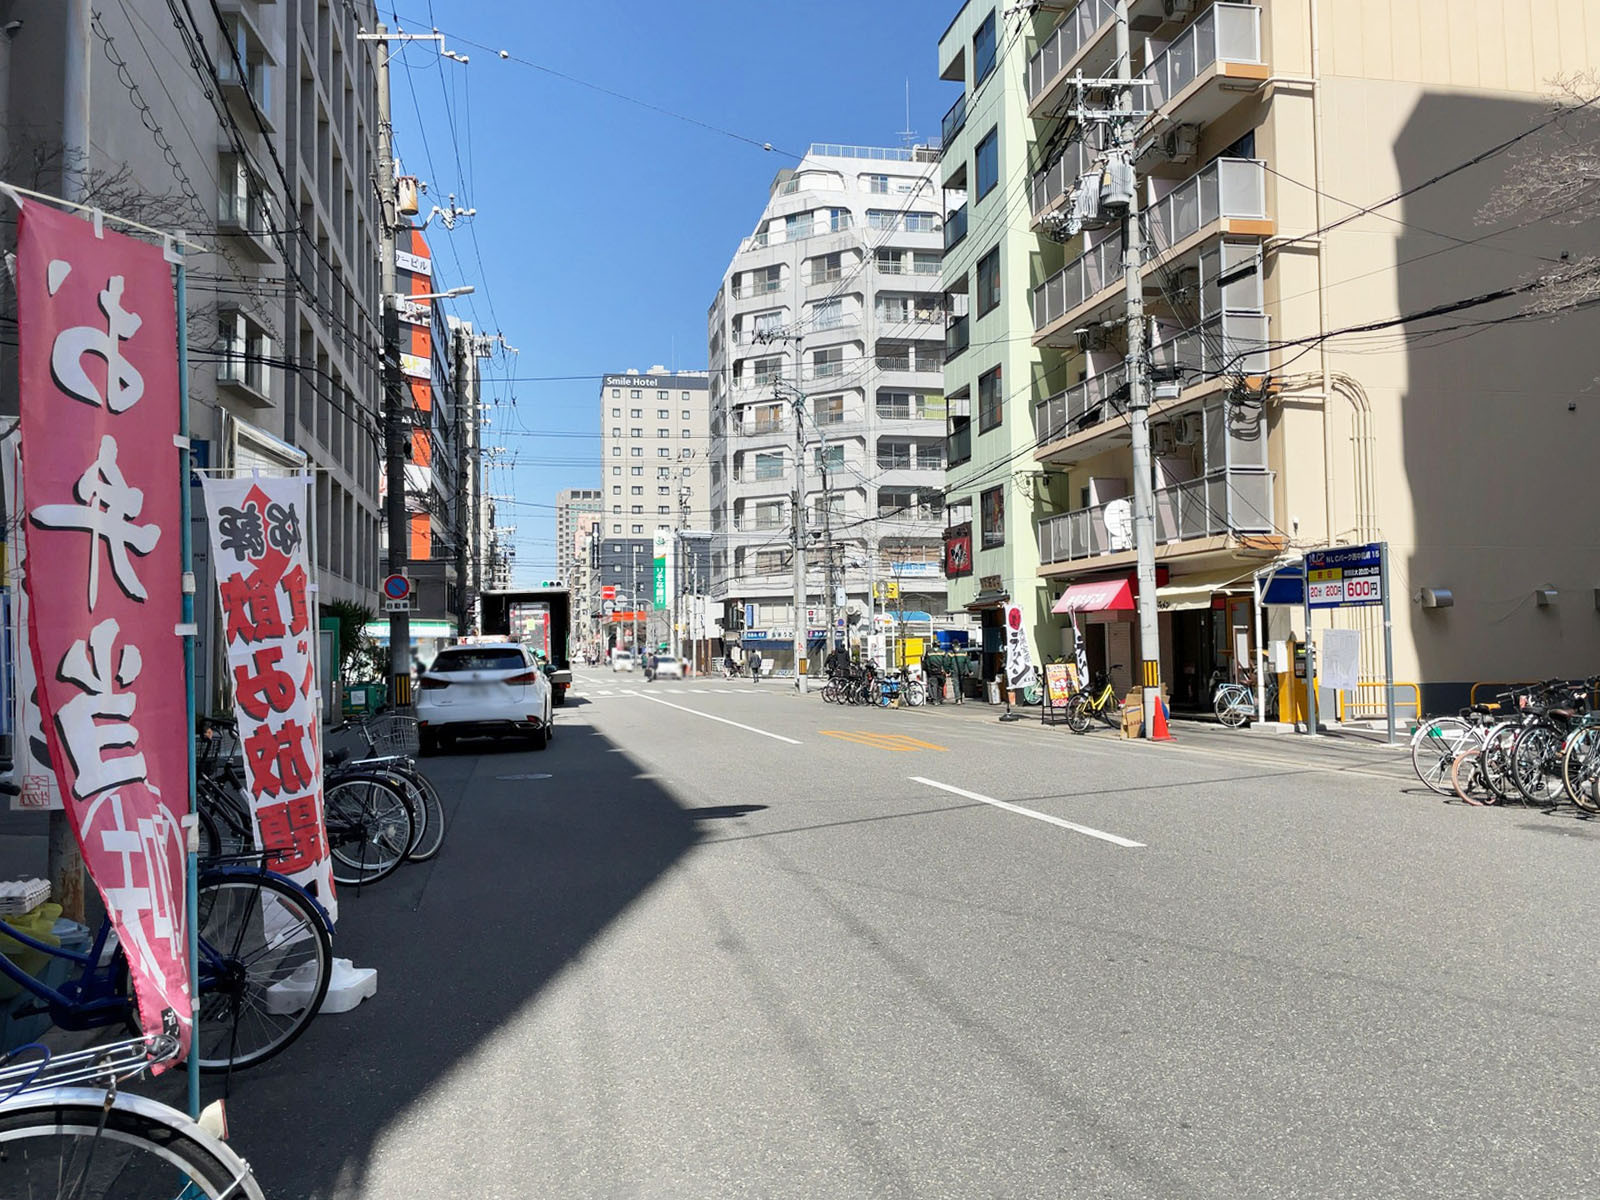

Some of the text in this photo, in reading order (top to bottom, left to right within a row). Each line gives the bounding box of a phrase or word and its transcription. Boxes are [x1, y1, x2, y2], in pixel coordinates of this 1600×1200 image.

[606, 376, 658, 387] Smile Hotel
[655, 567, 665, 605] りそな銀行
[1347, 581, 1378, 596] 600円
